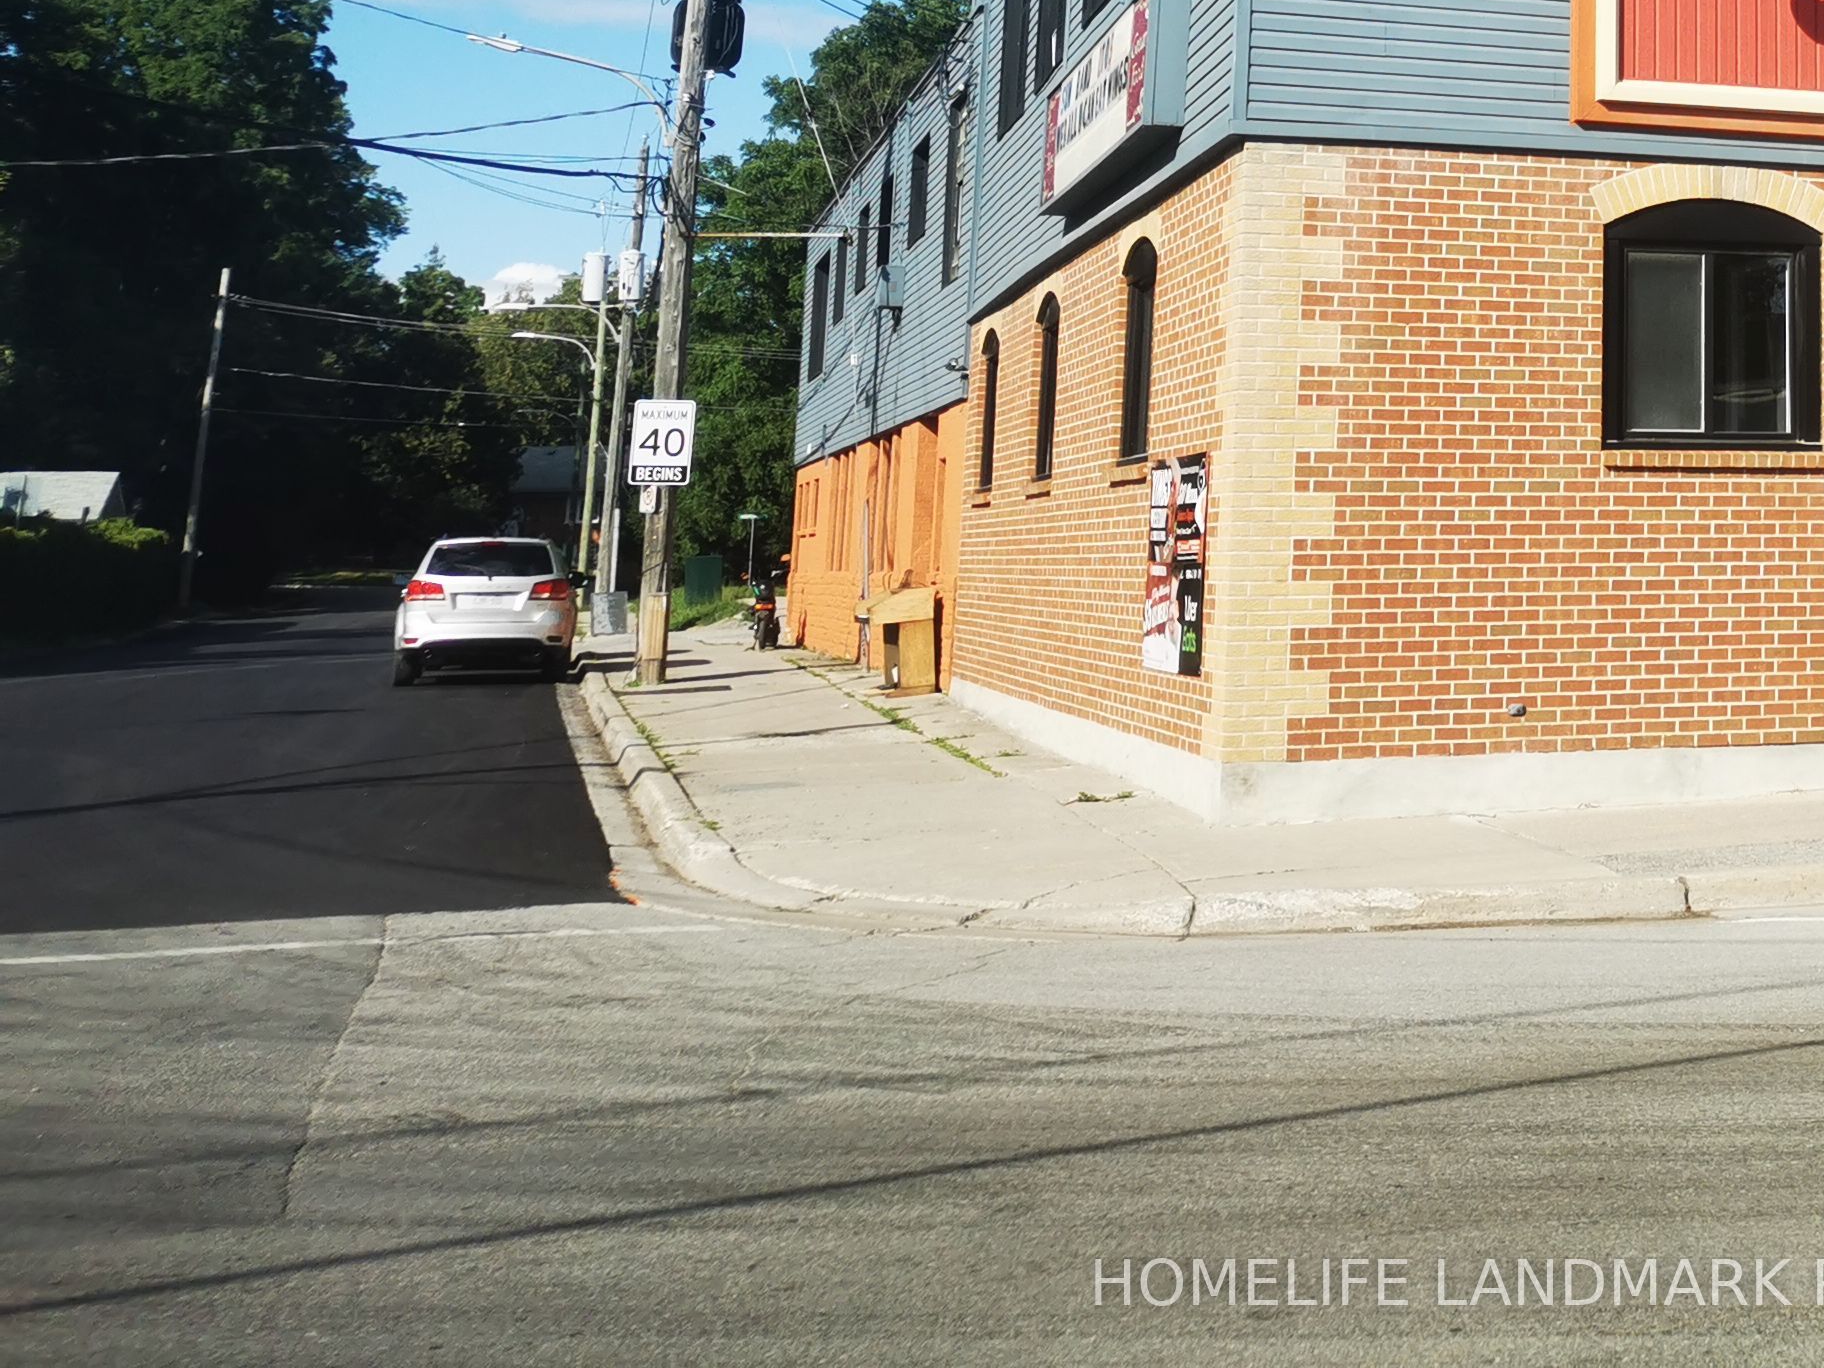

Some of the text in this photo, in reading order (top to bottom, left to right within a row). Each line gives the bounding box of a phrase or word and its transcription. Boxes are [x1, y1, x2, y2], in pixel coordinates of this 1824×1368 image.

[640, 410, 688, 420] MAXIMUM
[639, 428, 685, 457] 40
[635, 466, 683, 481] BEGINS
